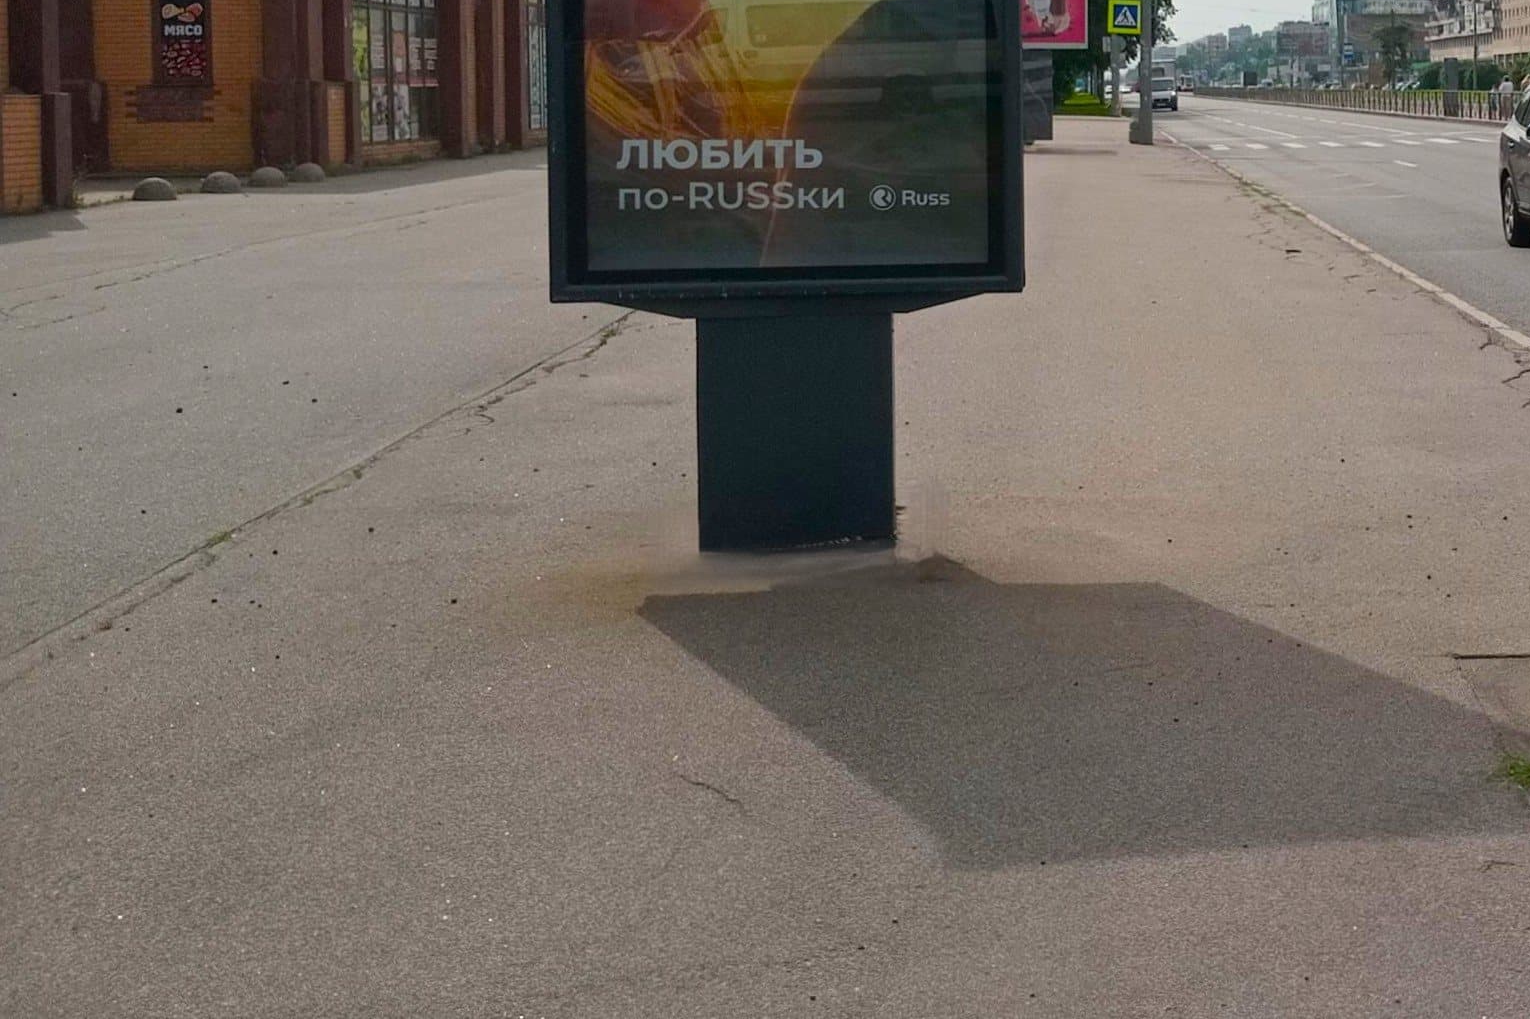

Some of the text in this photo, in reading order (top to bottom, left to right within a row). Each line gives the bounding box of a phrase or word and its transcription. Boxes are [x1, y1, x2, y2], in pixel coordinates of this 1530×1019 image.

[164, 24, 203, 36] МЯСО
[616, 139, 824, 170] ЛЮБИТЬ
[618, 181, 846, 211] по-RUSSки
[902, 190, 950, 206] Russ
